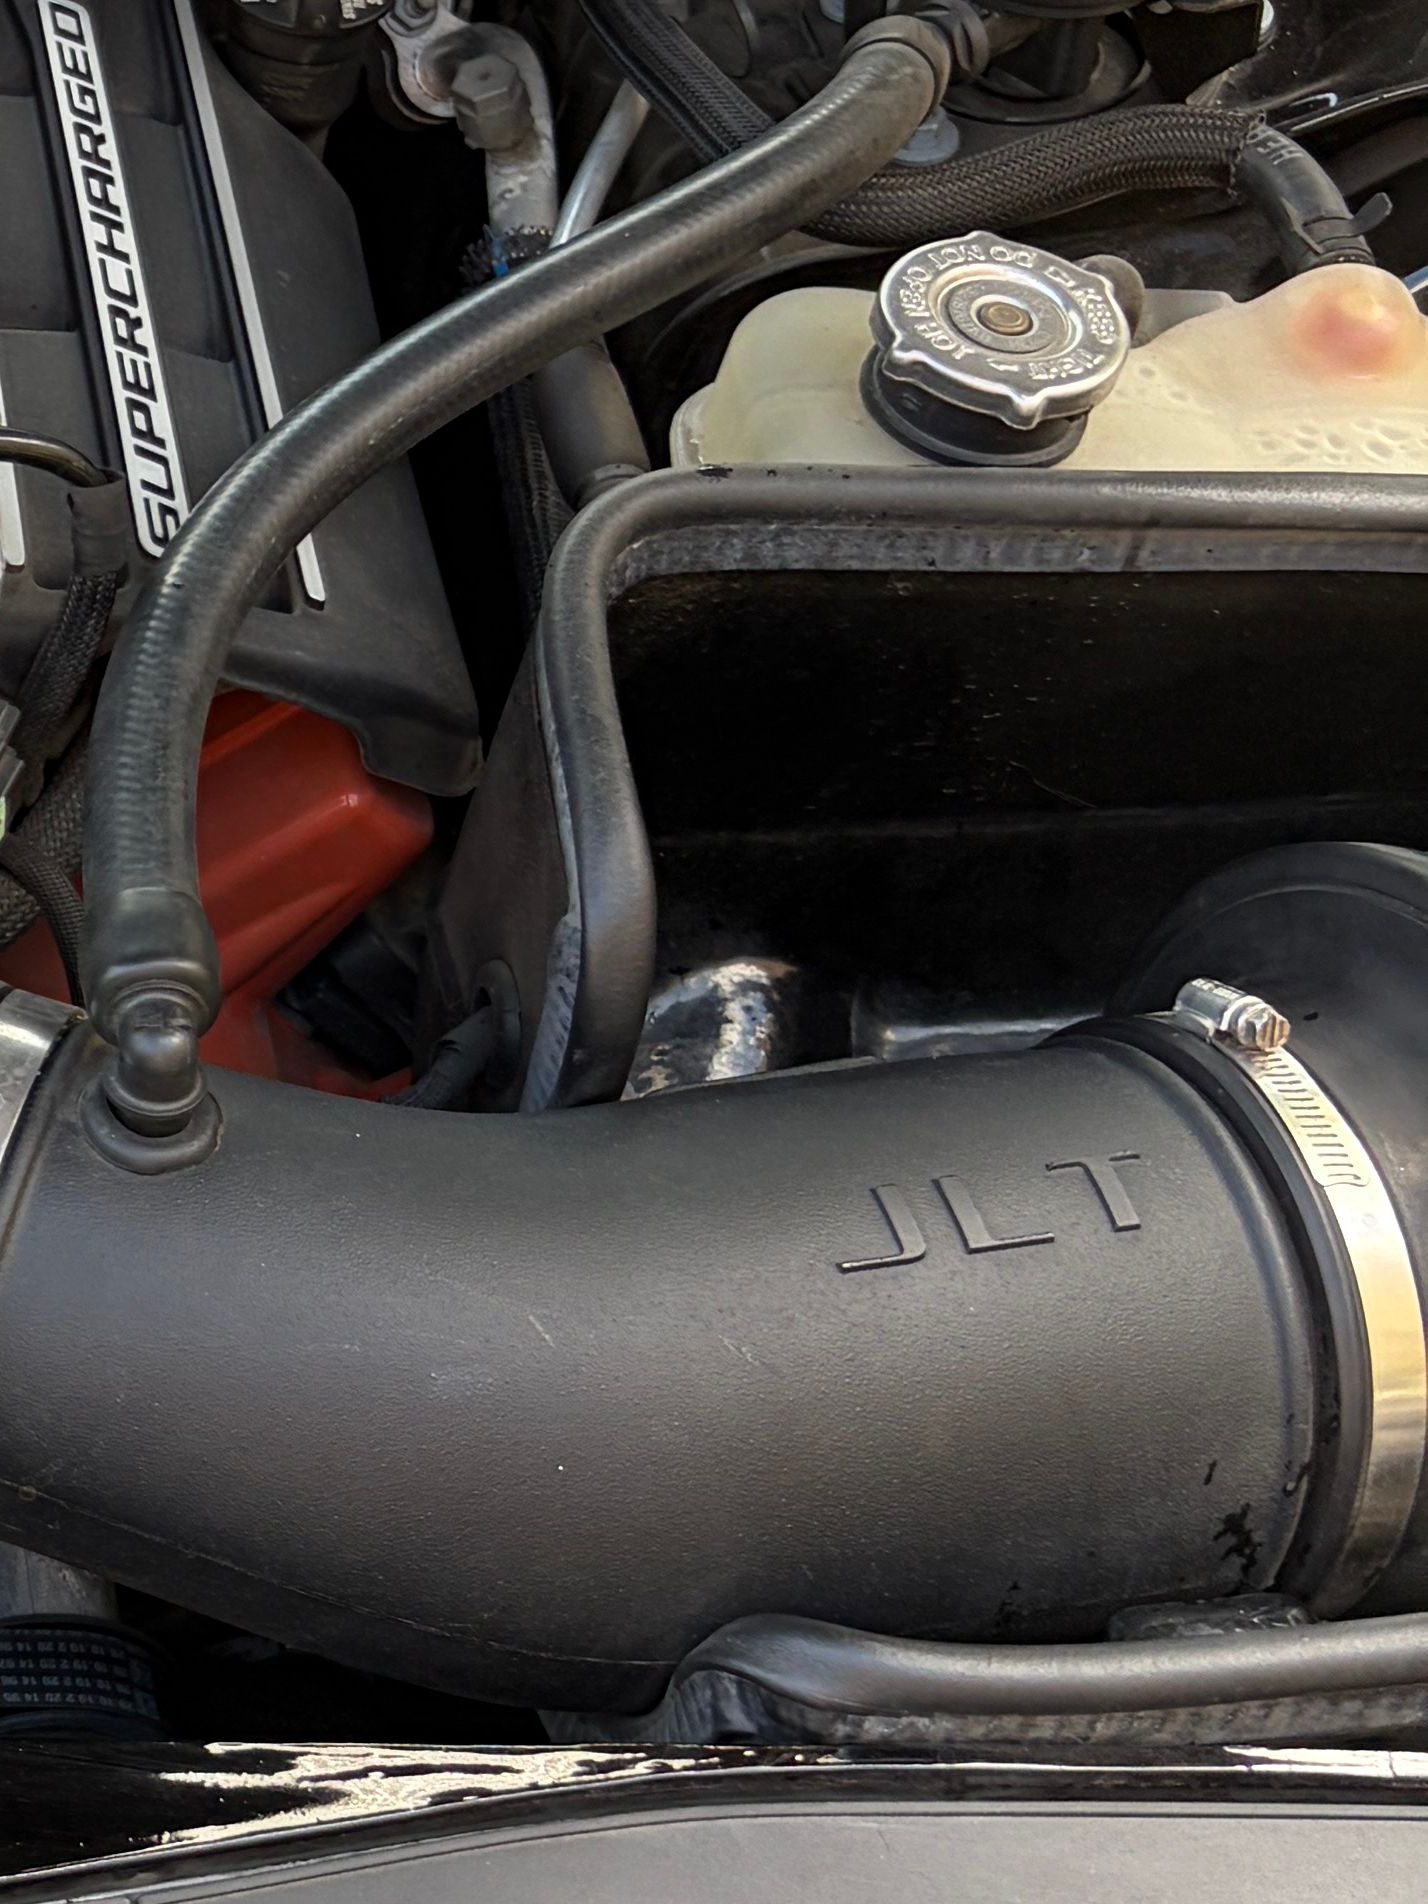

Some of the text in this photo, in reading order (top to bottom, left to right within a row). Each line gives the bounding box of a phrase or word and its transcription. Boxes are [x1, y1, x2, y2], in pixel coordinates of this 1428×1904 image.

[927, 244, 986, 270] NOT
[990, 246, 1037, 268] DO
[836, 1150, 1142, 1273] JLT
